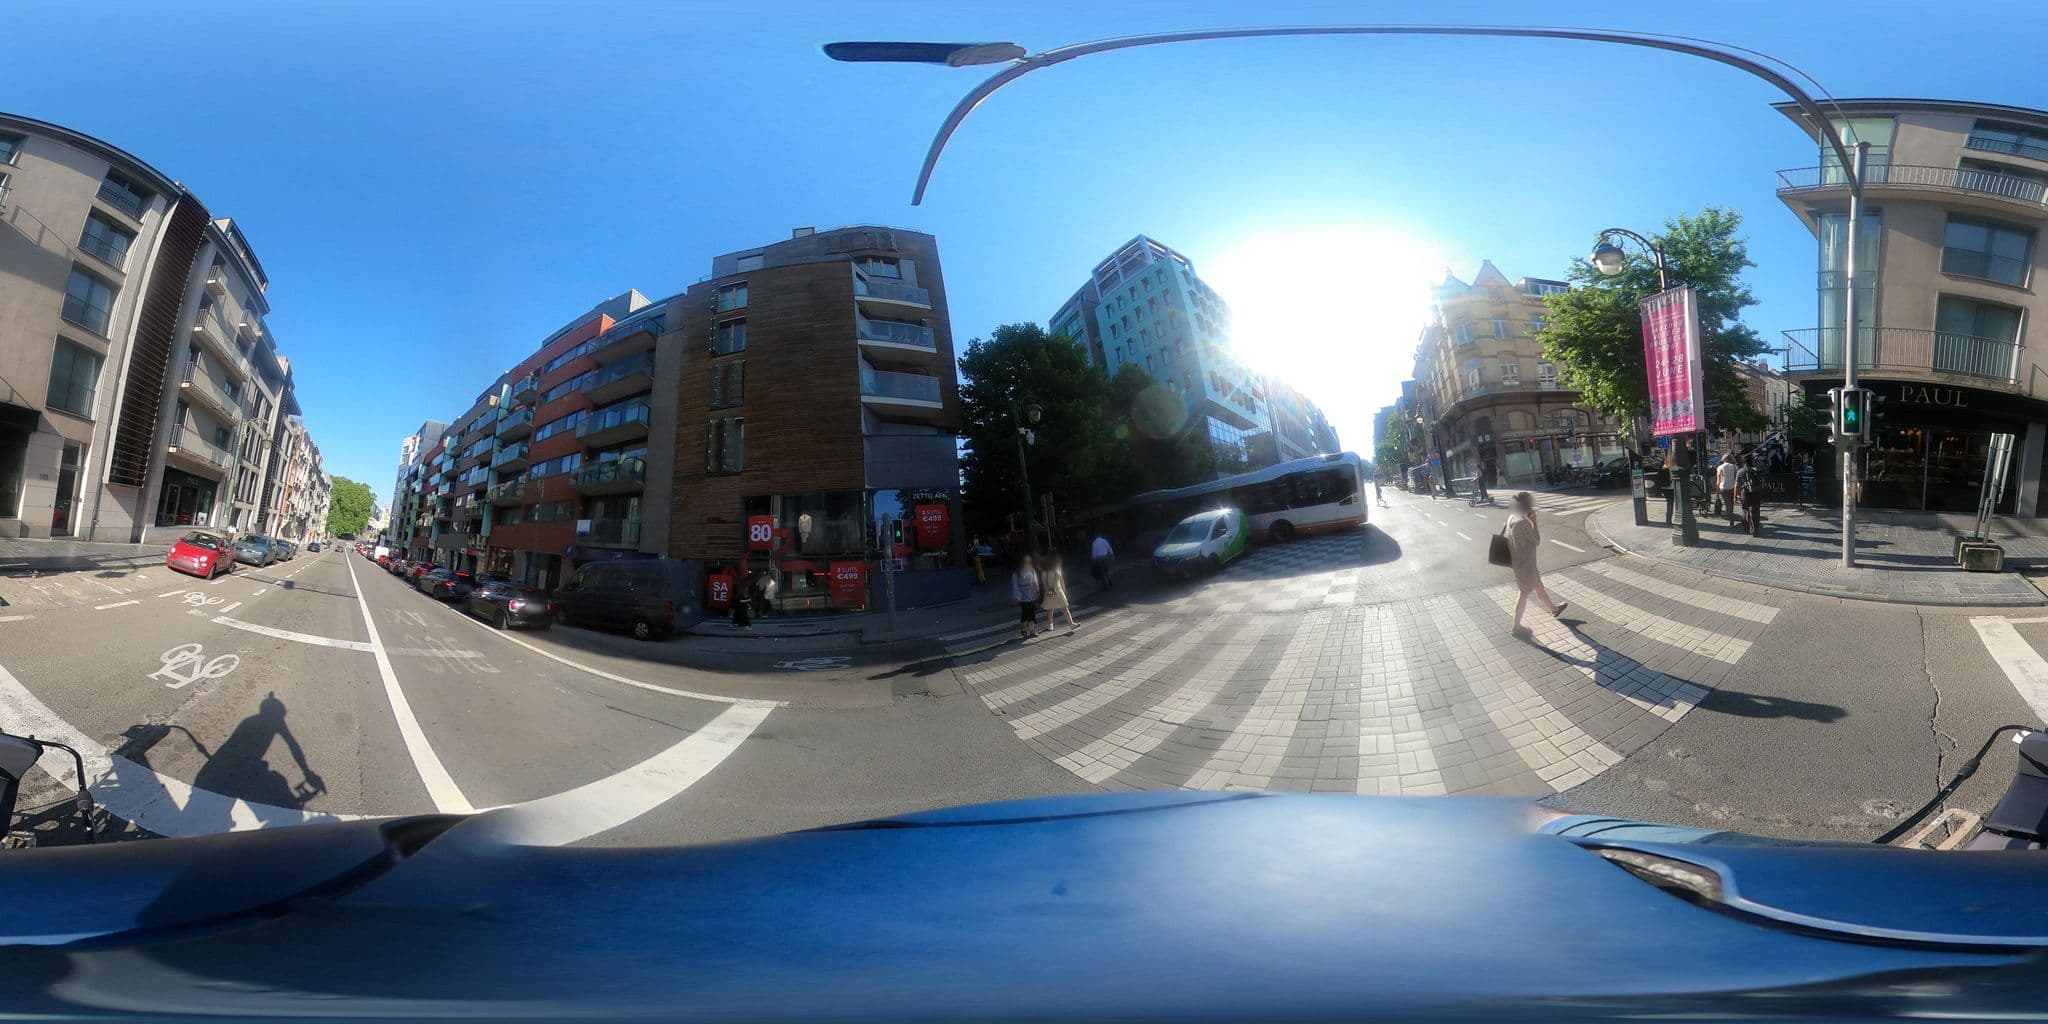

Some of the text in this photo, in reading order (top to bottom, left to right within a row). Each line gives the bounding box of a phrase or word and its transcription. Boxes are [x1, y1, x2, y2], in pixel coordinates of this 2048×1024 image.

[1899, 385, 1967, 407] PAUL
[751, 524, 772, 542] 80
[713, 581, 728, 592] SA
[713, 592, 727, 602] LE
